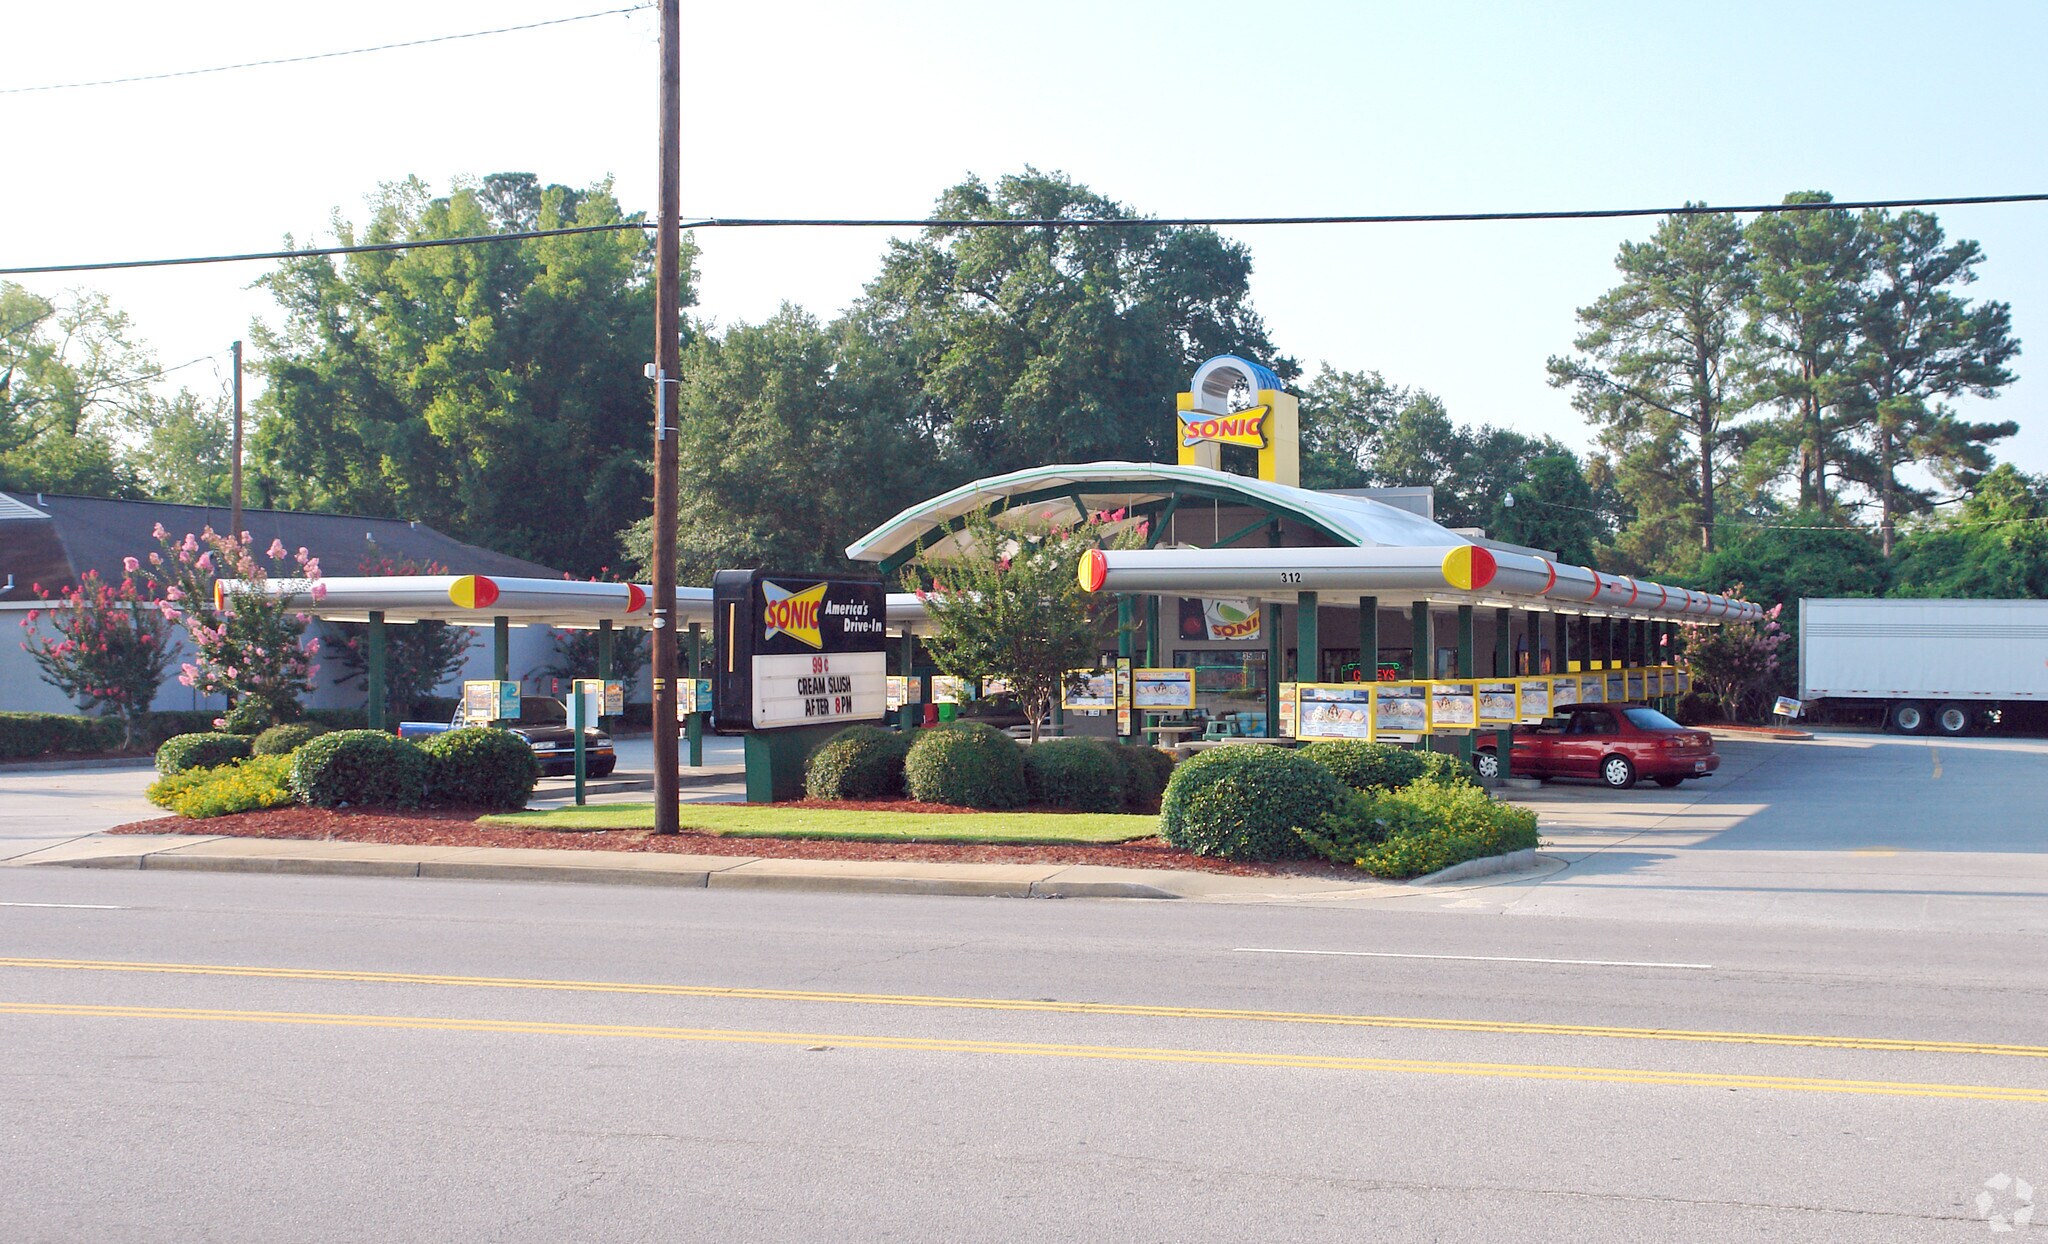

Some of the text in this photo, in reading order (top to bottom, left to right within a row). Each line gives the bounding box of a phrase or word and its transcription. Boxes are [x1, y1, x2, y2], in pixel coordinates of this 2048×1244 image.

[1187, 417, 1261, 439] SONIC
[1281, 572, 1301, 583] 312
[767, 599, 821, 629] SONIC
[825, 599, 869, 616] America's
[797, 675, 851, 696] CREAM SLUSH
[805, 698, 830, 717] AFTER
